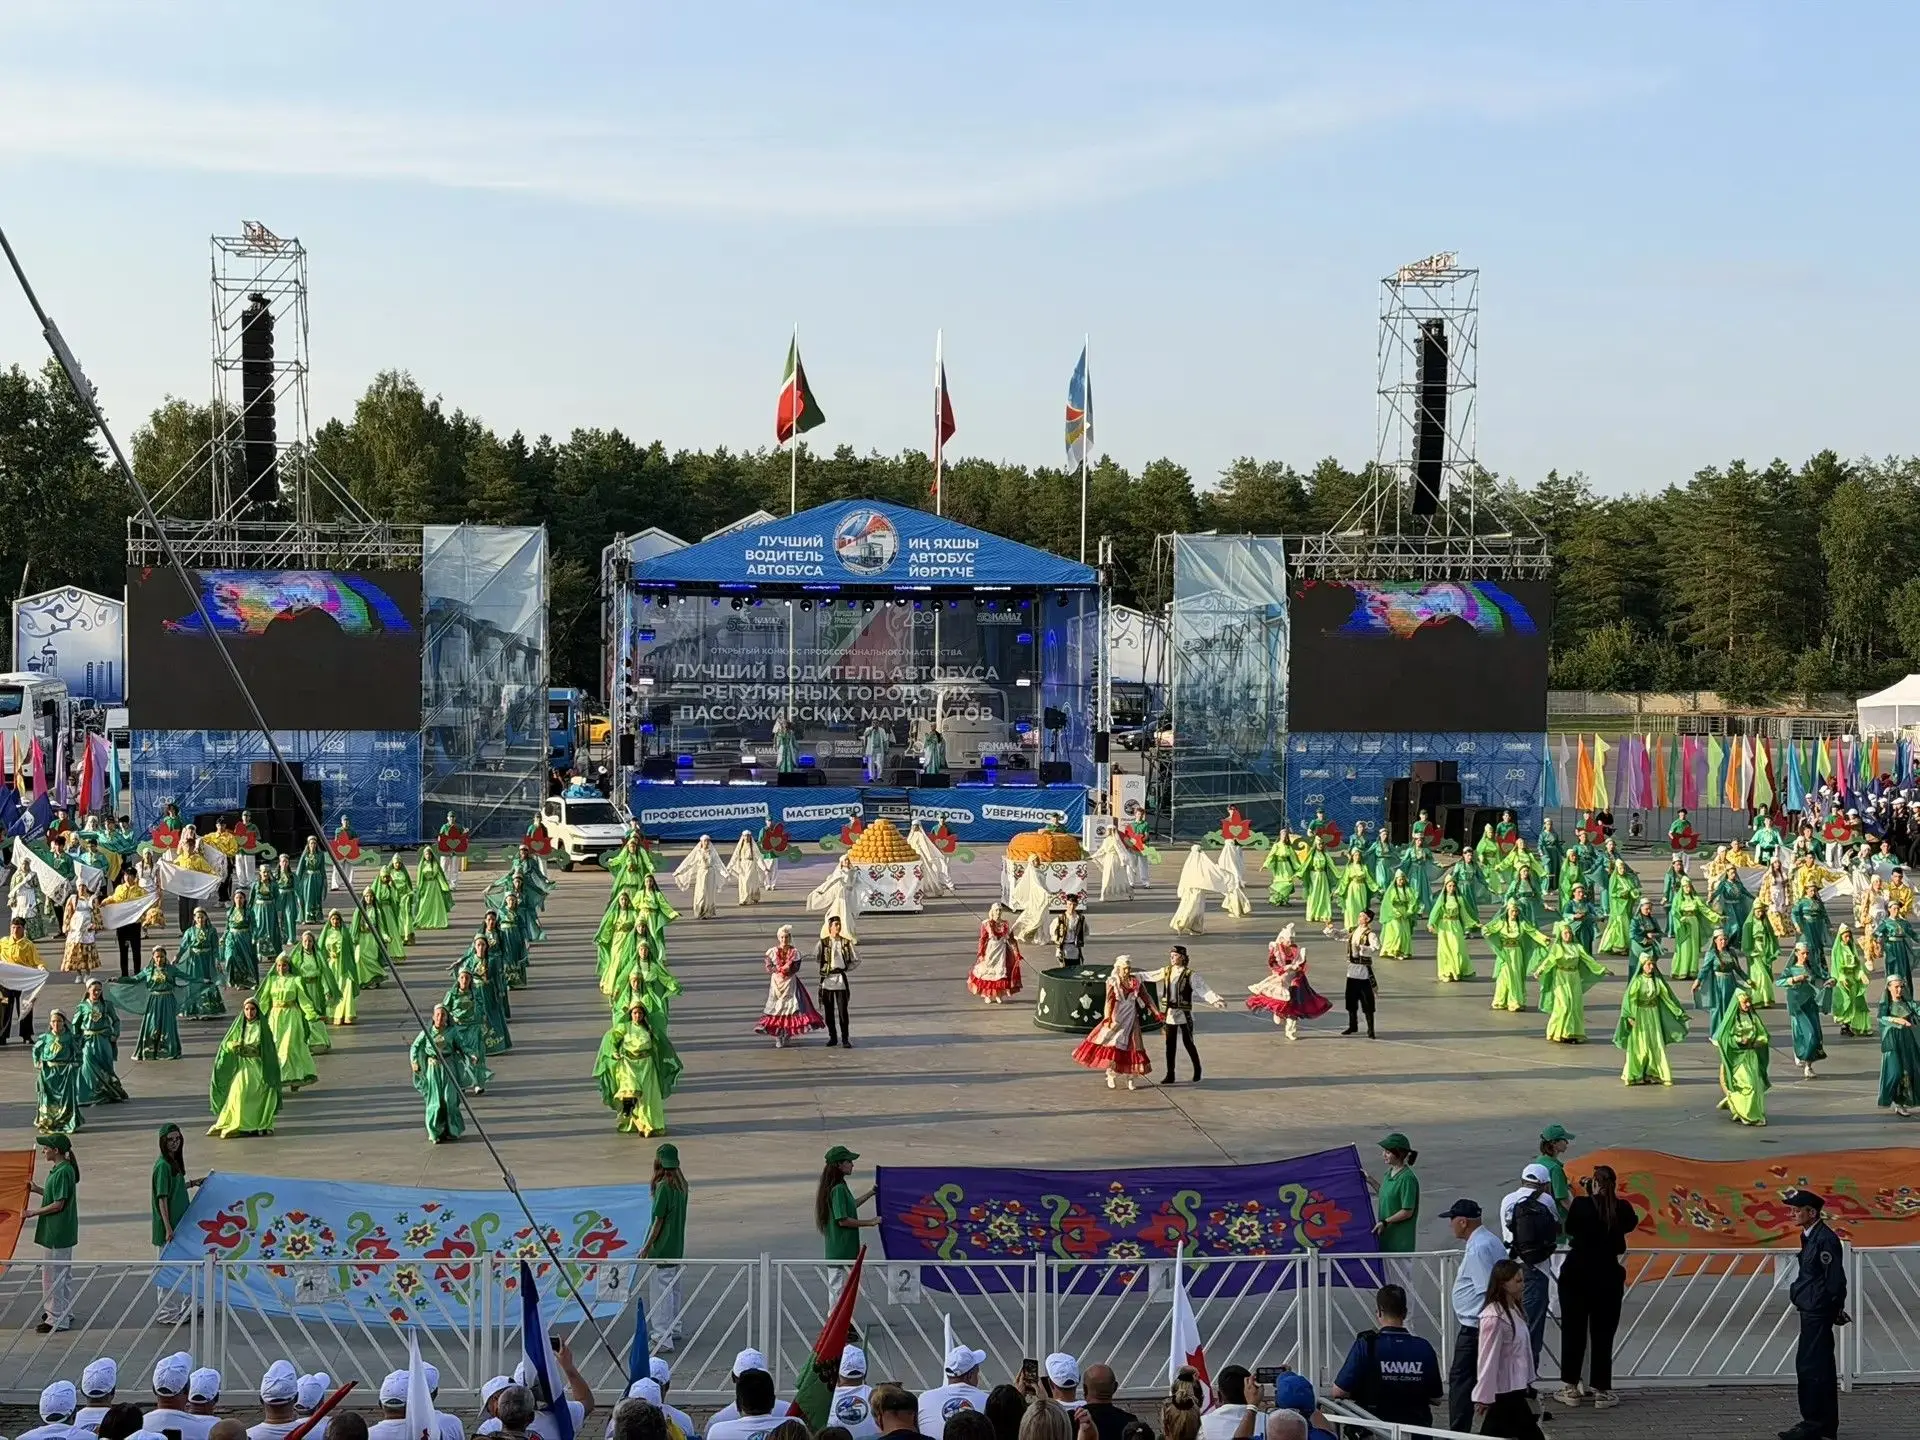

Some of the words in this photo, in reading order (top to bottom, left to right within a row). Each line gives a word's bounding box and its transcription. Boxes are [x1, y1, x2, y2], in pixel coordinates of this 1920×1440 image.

[758, 534, 824, 548] ЛУЧШИЙ
[908, 538, 930, 551] ИҢ
[934, 538, 979, 549] ЯХШЫ
[745, 551, 824, 563] ВОДИТЕЛЬ
[908, 552, 975, 564] АВТОБУС
[746, 565, 824, 577] АВТОБУСА
[711, 647, 760, 655] ОТКРЫТЫЙ
[672, 662, 766, 679] ЛУЧШИЙ
[773, 665, 885, 682] ВОДИТЕЛЬ
[889, 665, 1000, 680] АВТОБУСА
[702, 684, 841, 700] РЕГУЛЯРНЫХ
[680, 705, 856, 721] ПАССАЖИРСКИХ
[860, 706, 994, 721] МАРШРУТОВ
[643, 805, 767, 822] ПРОФЕССИОНАЛИЗМ
[786, 805, 861, 819] МАСТЕРСТВО
[985, 807, 1065, 821] УВЕРЕННОСЬ
[608, 1266, 620, 1289] 3
[899, 1269, 911, 1292] 2
[1161, 1267, 1170, 1289] 1
[1380, 1360, 1424, 1374] KAMAZ
